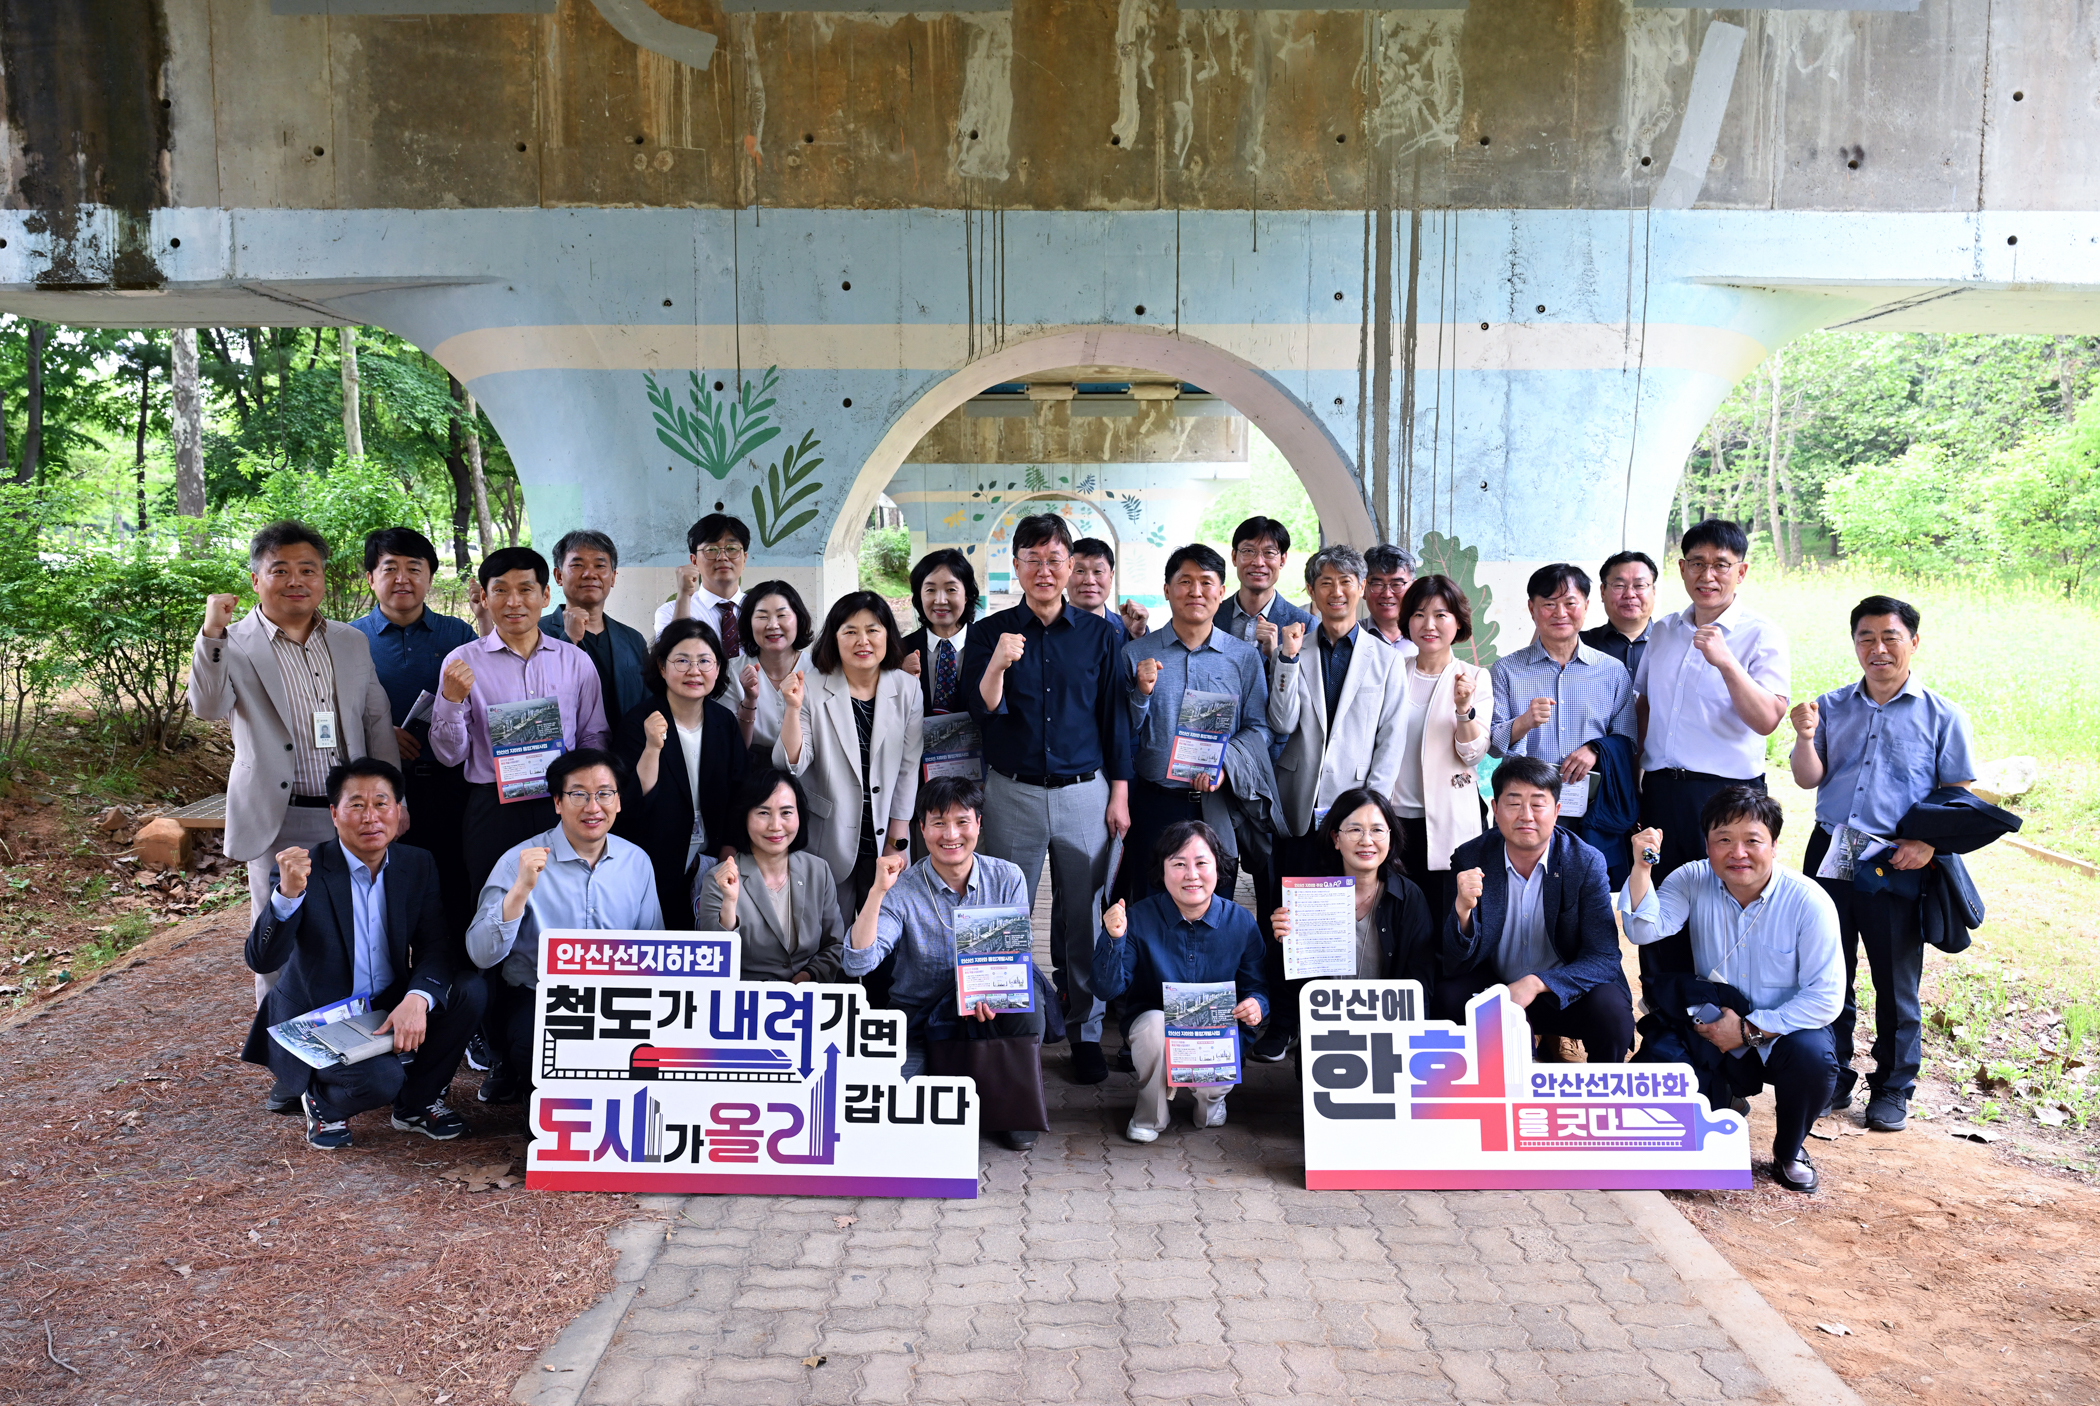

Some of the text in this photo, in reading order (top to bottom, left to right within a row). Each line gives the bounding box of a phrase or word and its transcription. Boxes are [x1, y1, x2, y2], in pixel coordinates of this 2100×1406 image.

[555, 943, 725, 974] 안산선지하화
[545, 984, 698, 1041] 철도가
[1309, 988, 1416, 1021] 안산에
[1530, 1072, 1690, 1098] 안산선지하화
